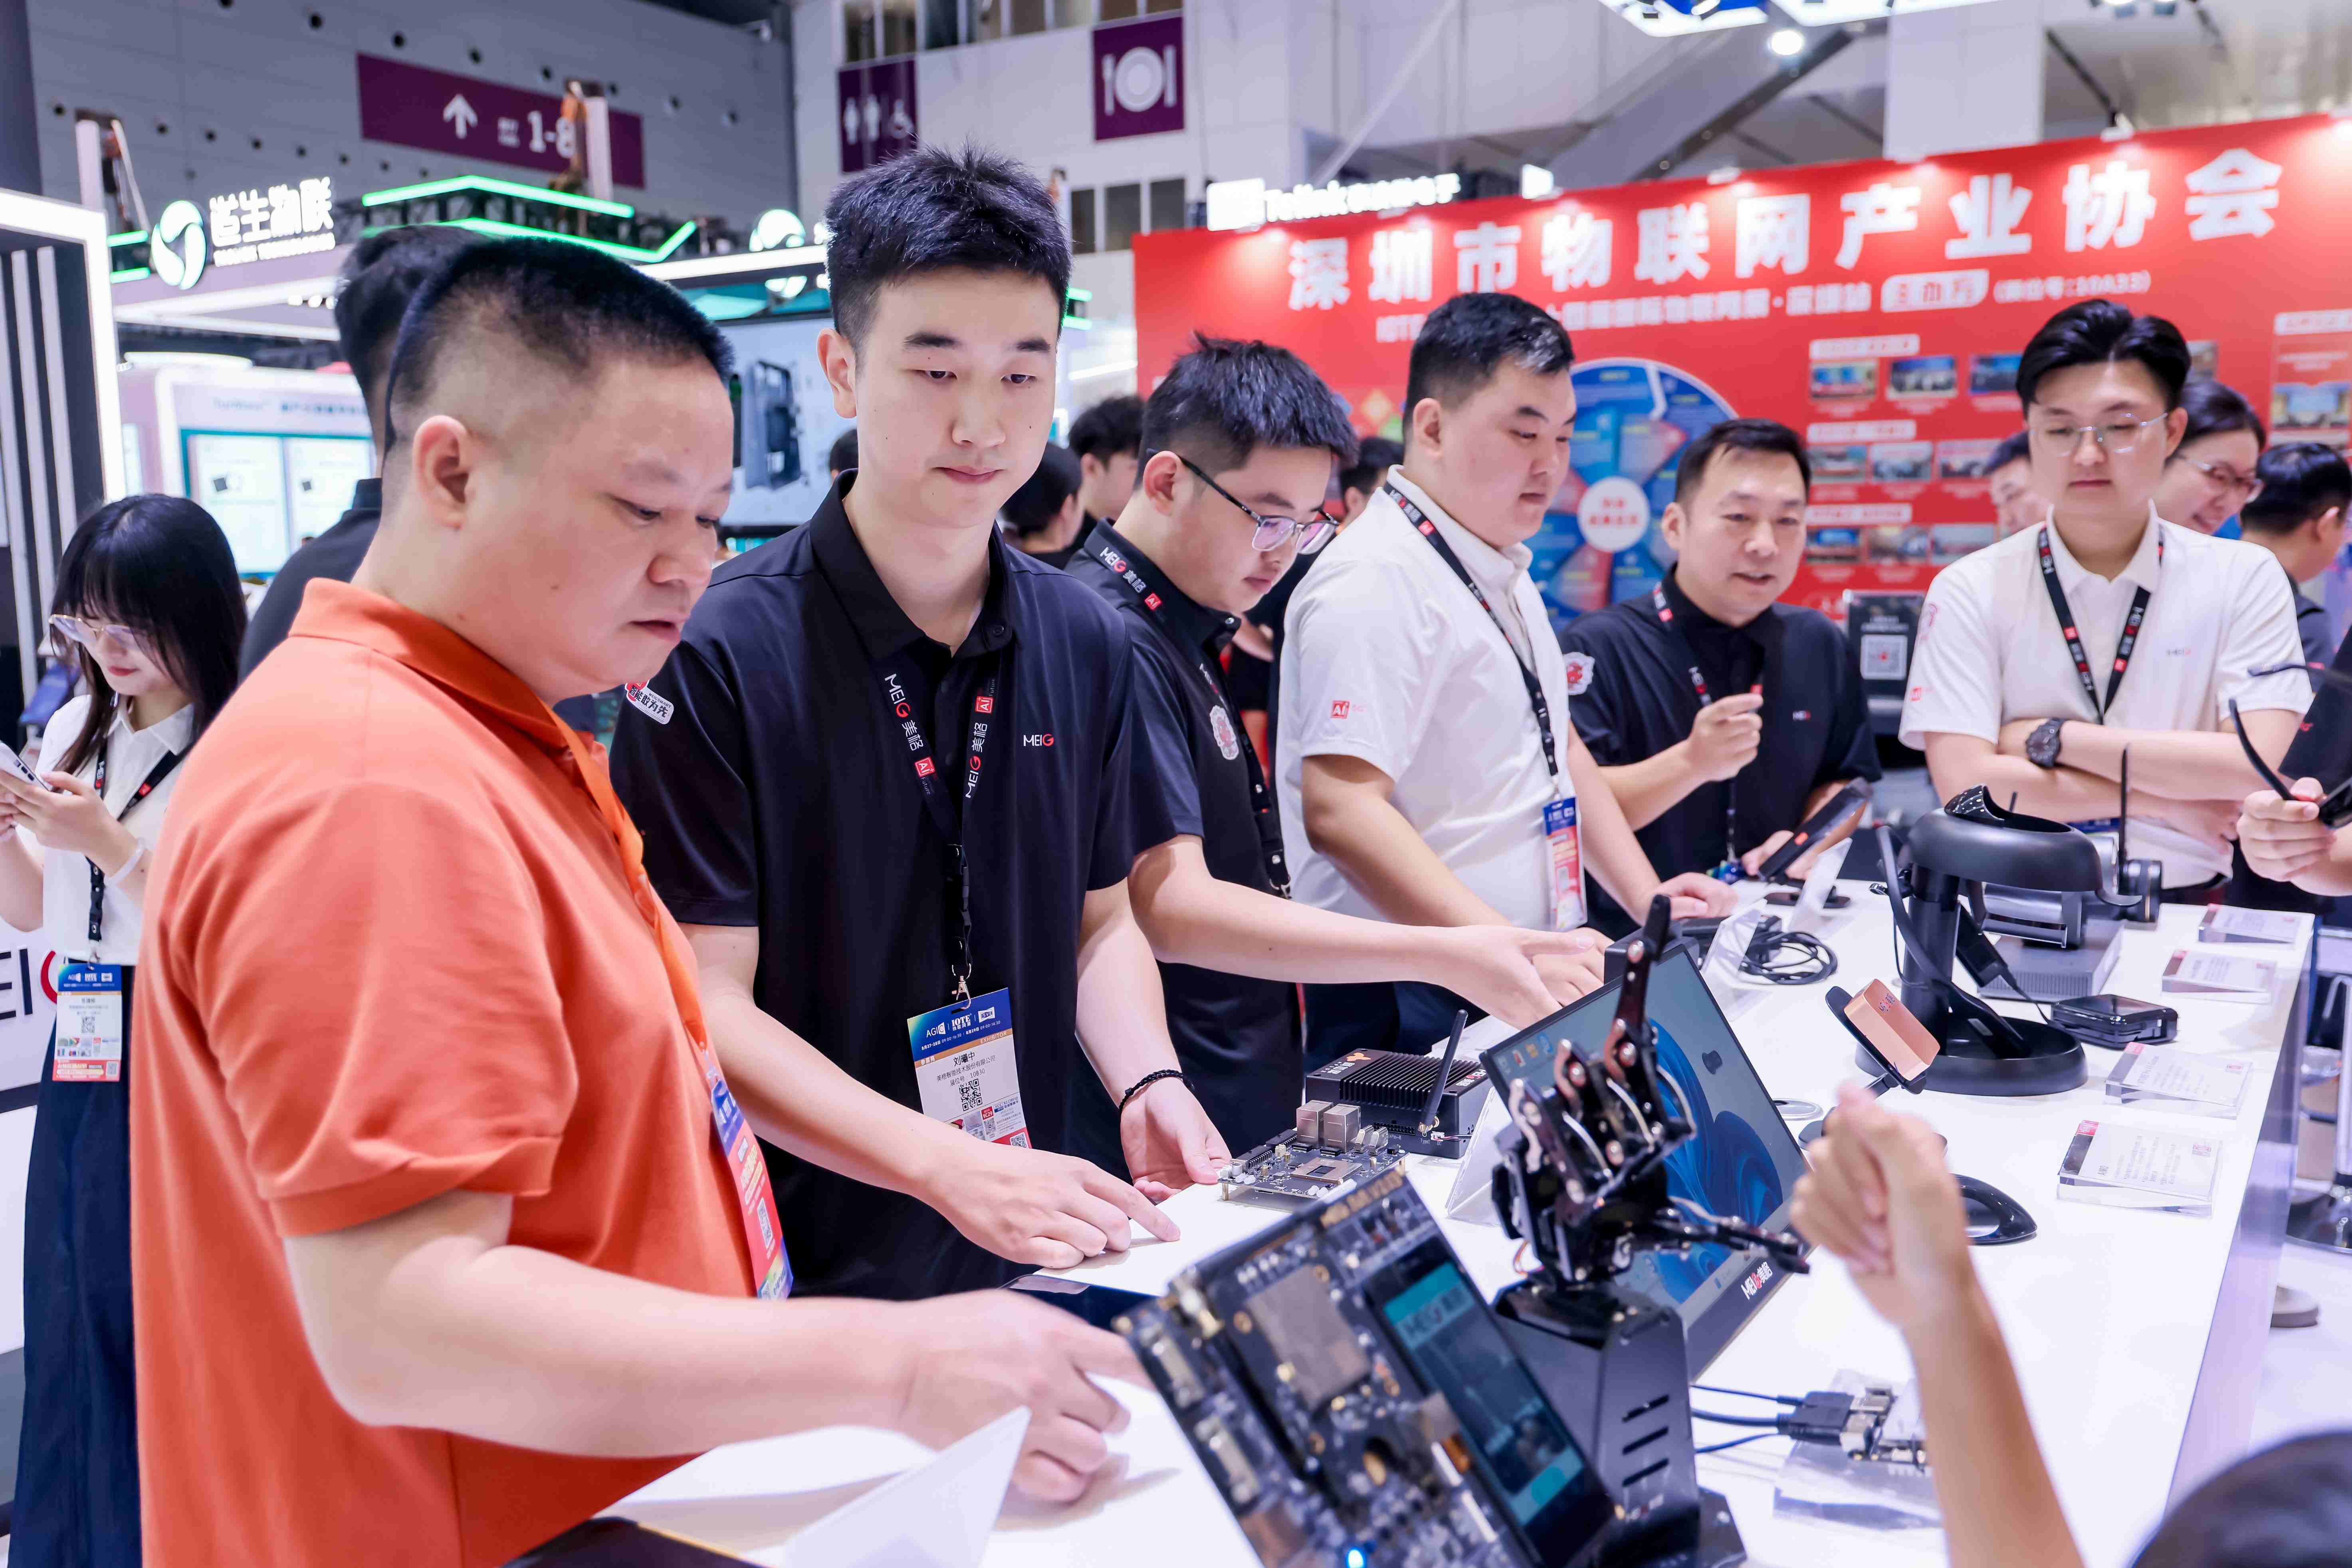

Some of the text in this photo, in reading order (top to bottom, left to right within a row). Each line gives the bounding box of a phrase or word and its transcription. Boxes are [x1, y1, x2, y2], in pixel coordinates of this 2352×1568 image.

[1288, 148, 2283, 310] 深圳市物联网产业协会
[1100, 547, 1126, 572] MEIG
[630, 684, 668, 718] 智能敢为先
[885, 674, 910, 718] MEIG
[902, 720, 923, 751] 美格
[971, 722, 987, 753] 美格
[1023, 734, 1054, 746] MEIG
[965, 755, 981, 798] MEIG
[980, 1031, 1007, 1044] EXHIBITOR
[982, 1110, 993, 1119] 9C29
[1740, 1272, 1762, 1300] MEIG
